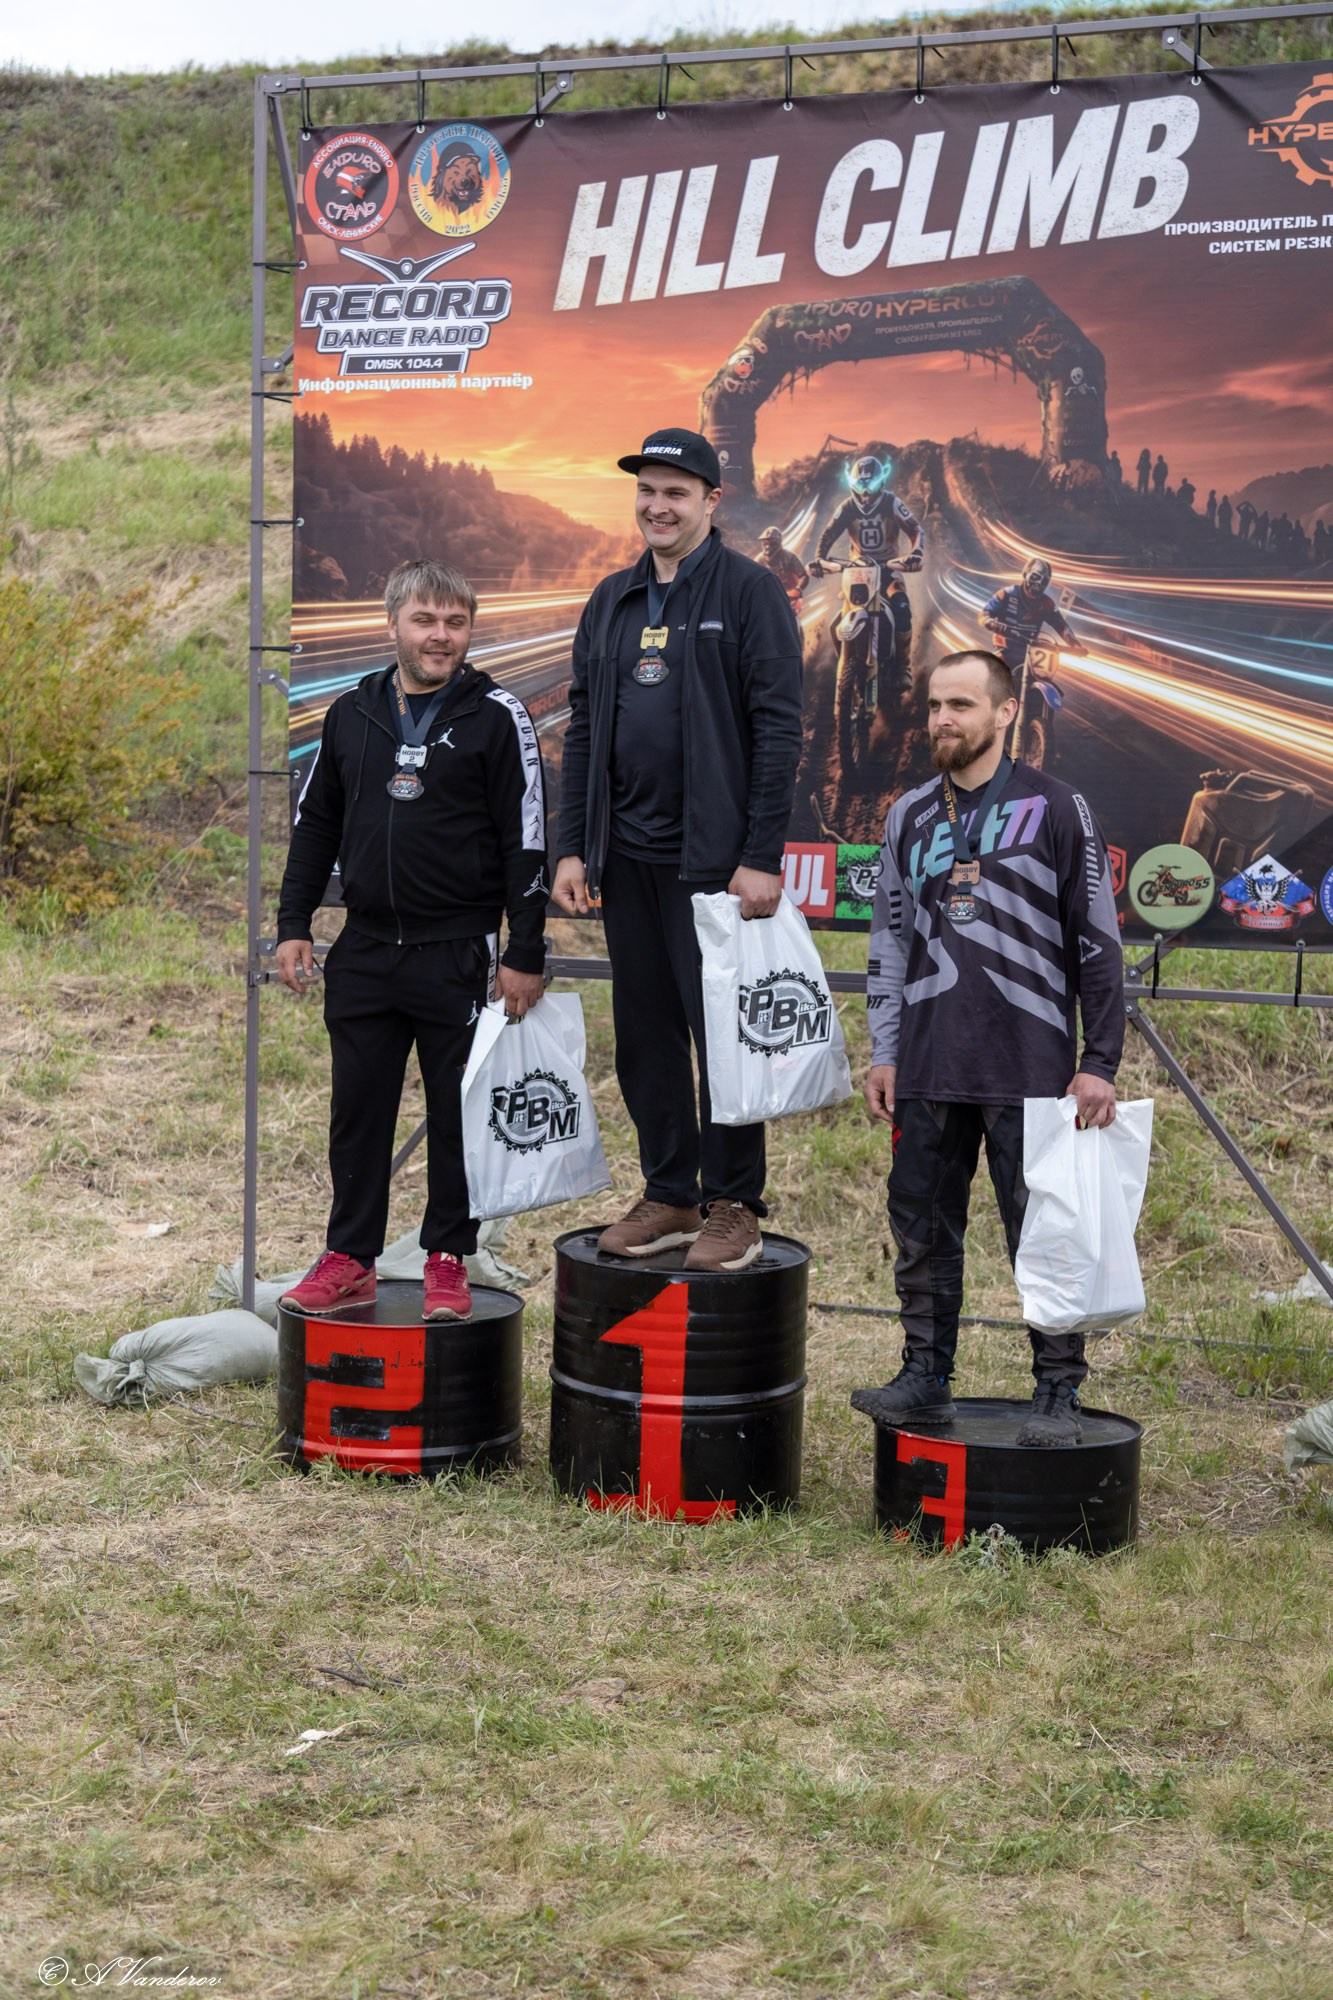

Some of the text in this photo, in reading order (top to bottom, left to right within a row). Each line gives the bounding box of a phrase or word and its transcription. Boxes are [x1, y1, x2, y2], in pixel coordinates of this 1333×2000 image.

[323, 152, 381, 178] ENDURO
[553, 94, 1200, 311] HILL CLIMB
[445, 224, 471, 234] 2022
[1164, 215, 1318, 235] ПРОИЗВОДИТЕЛЬ
[1208, 239, 1280, 254] СИСТЕМ
[302, 283, 511, 324] RECORD
[322, 325, 486, 348] DANCE RADIO
[364, 357, 443, 370] OMSK 104.4
[299, 373, 533, 393] Информационный партнёр
[643, 446, 682, 455] SIBERIA
[492, 690, 539, 767] JORDAN
[781, 853, 829, 906] UL
[304, 1319, 425, 1476] 2
[586, 1281, 738, 1524] 1
